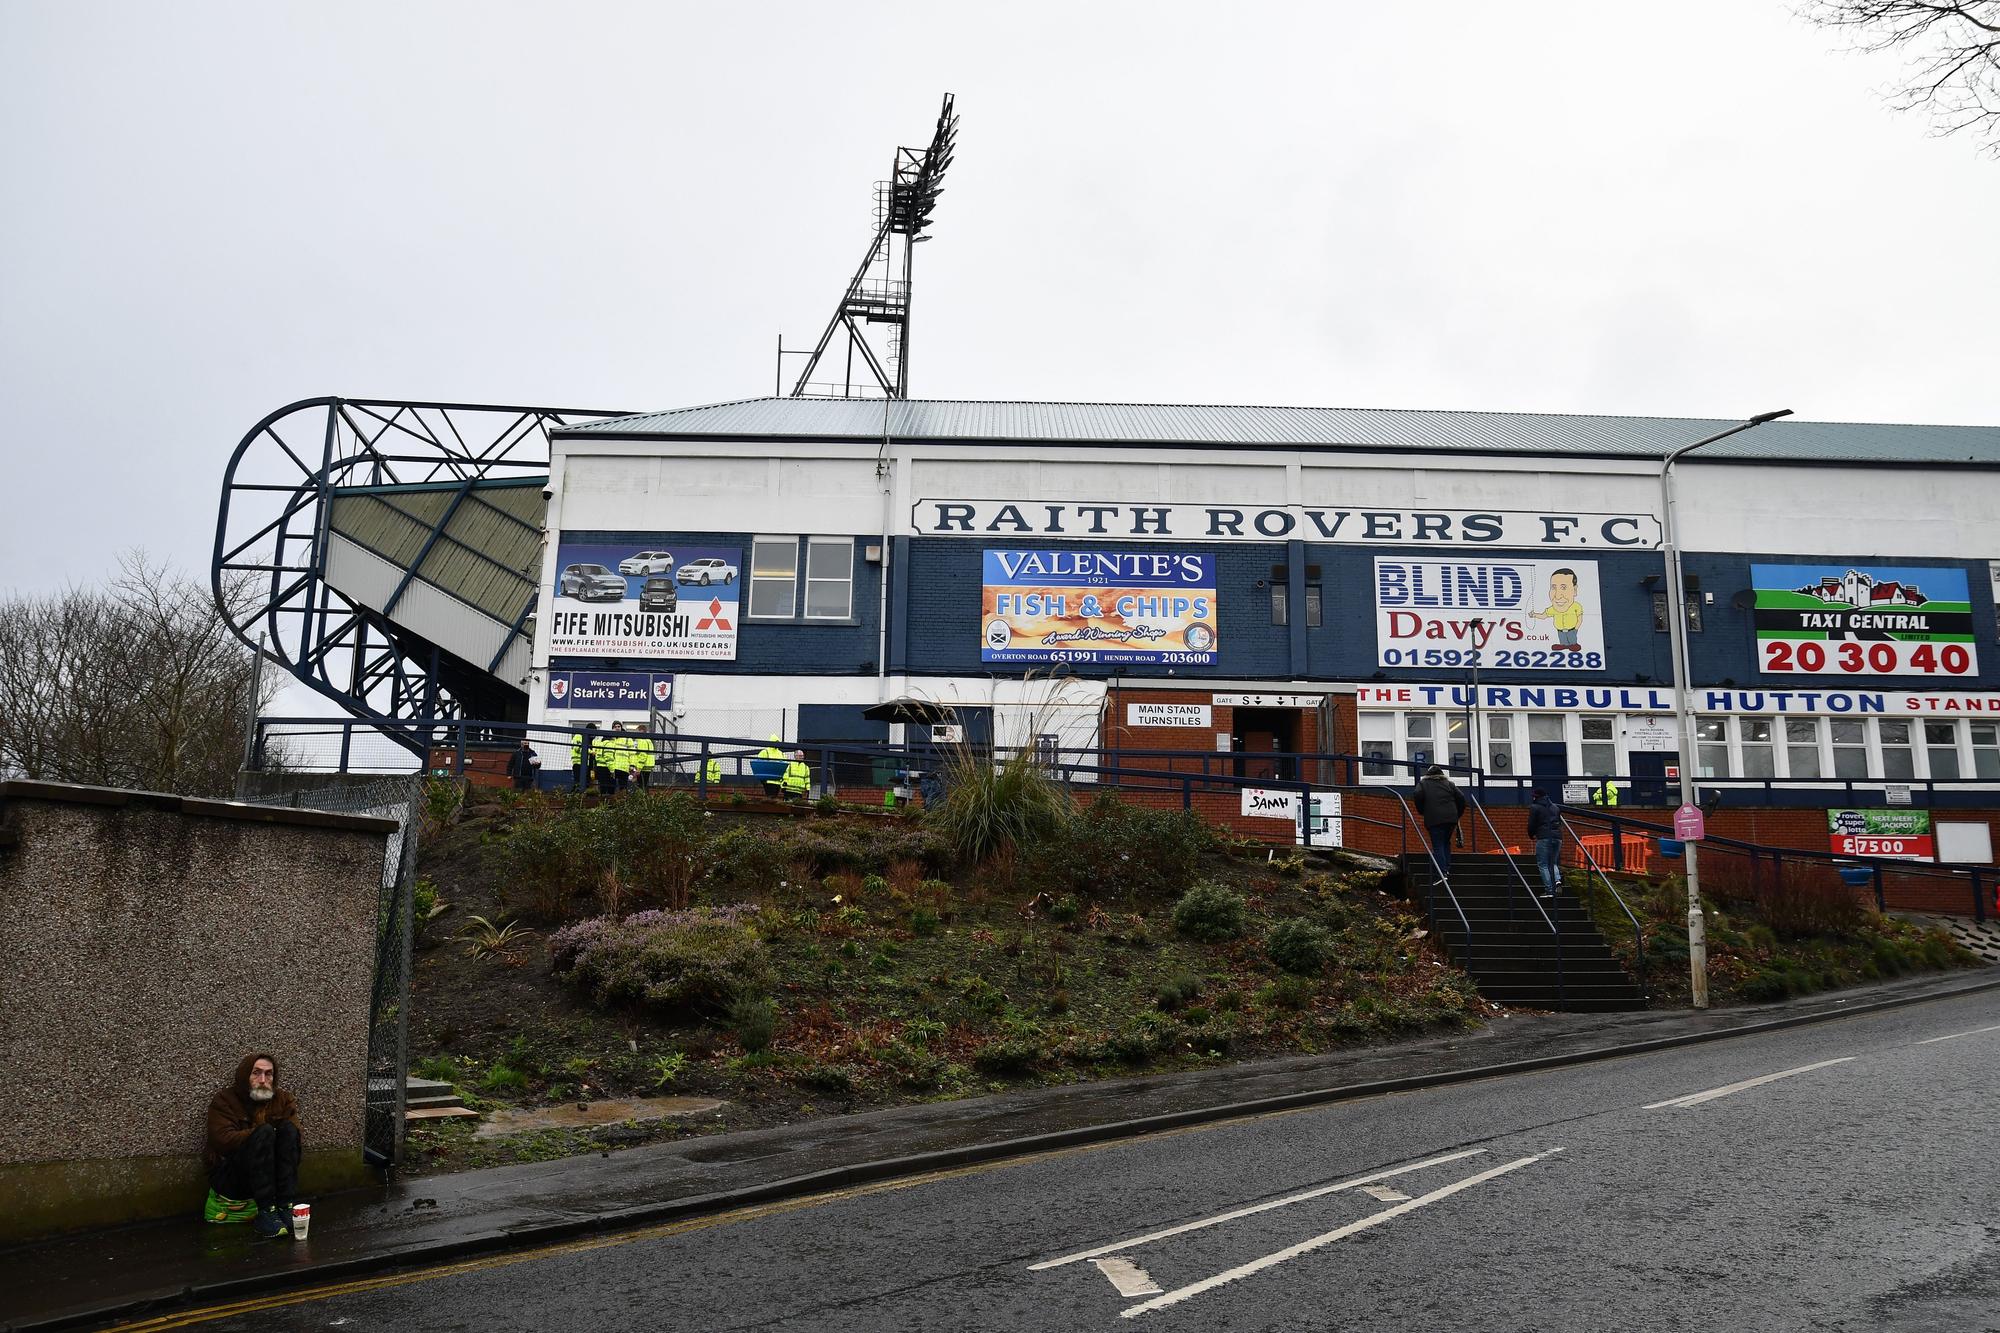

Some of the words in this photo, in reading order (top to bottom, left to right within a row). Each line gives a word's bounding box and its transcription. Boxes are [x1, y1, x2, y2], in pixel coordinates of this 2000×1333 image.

[934, 503, 1172, 534] RAITH
[1205, 508, 1503, 541] ROVERS
[1539, 516, 1648, 545] F.C.
[994, 552, 1203, 582] VALENTE'S
[1379, 564, 1522, 607] BLIND
[997, 594, 1066, 616] FISH
[1080, 595, 1103, 618] &
[1116, 596, 1209, 619] CHIPS
[553, 612, 588, 635] FIFE
[594, 613, 689, 638] MITSUBISHI
[1387, 611, 1524, 649] Davy's
[1524, 633, 1549, 641] .co.uk
[1800, 613, 1842, 628] TAXI
[1849, 614, 1930, 630] CENTRAL
[1132, 625, 1166, 641] Shops
[1050, 651, 1097, 662] 651991
[1161, 653, 1210, 663] 203600
[1384, 649, 1482, 667] 01592
[1495, 650, 1602, 668] 262288
[1766, 641, 1826, 672] 20
[1838, 642, 1897, 673] 30
[1910, 644, 1969, 674] 40
[573, 687, 614, 699] Stark's
[619, 689, 647, 699] Park
[1242, 696, 1250, 705] S
[1291, 697, 1298, 706] T
[1357, 688, 1411, 702] THE
[1419, 686, 1670, 709] TURNBULL
[1706, 691, 1885, 712] HUTTON
[1906, 697, 2000, 711] STAND
[1138, 705, 1165, 714] MAIN
[1167, 706, 1201, 715] STAND
[1138, 716, 1201, 726] TURNSTILES
[1249, 795, 1288, 810] SAMH
